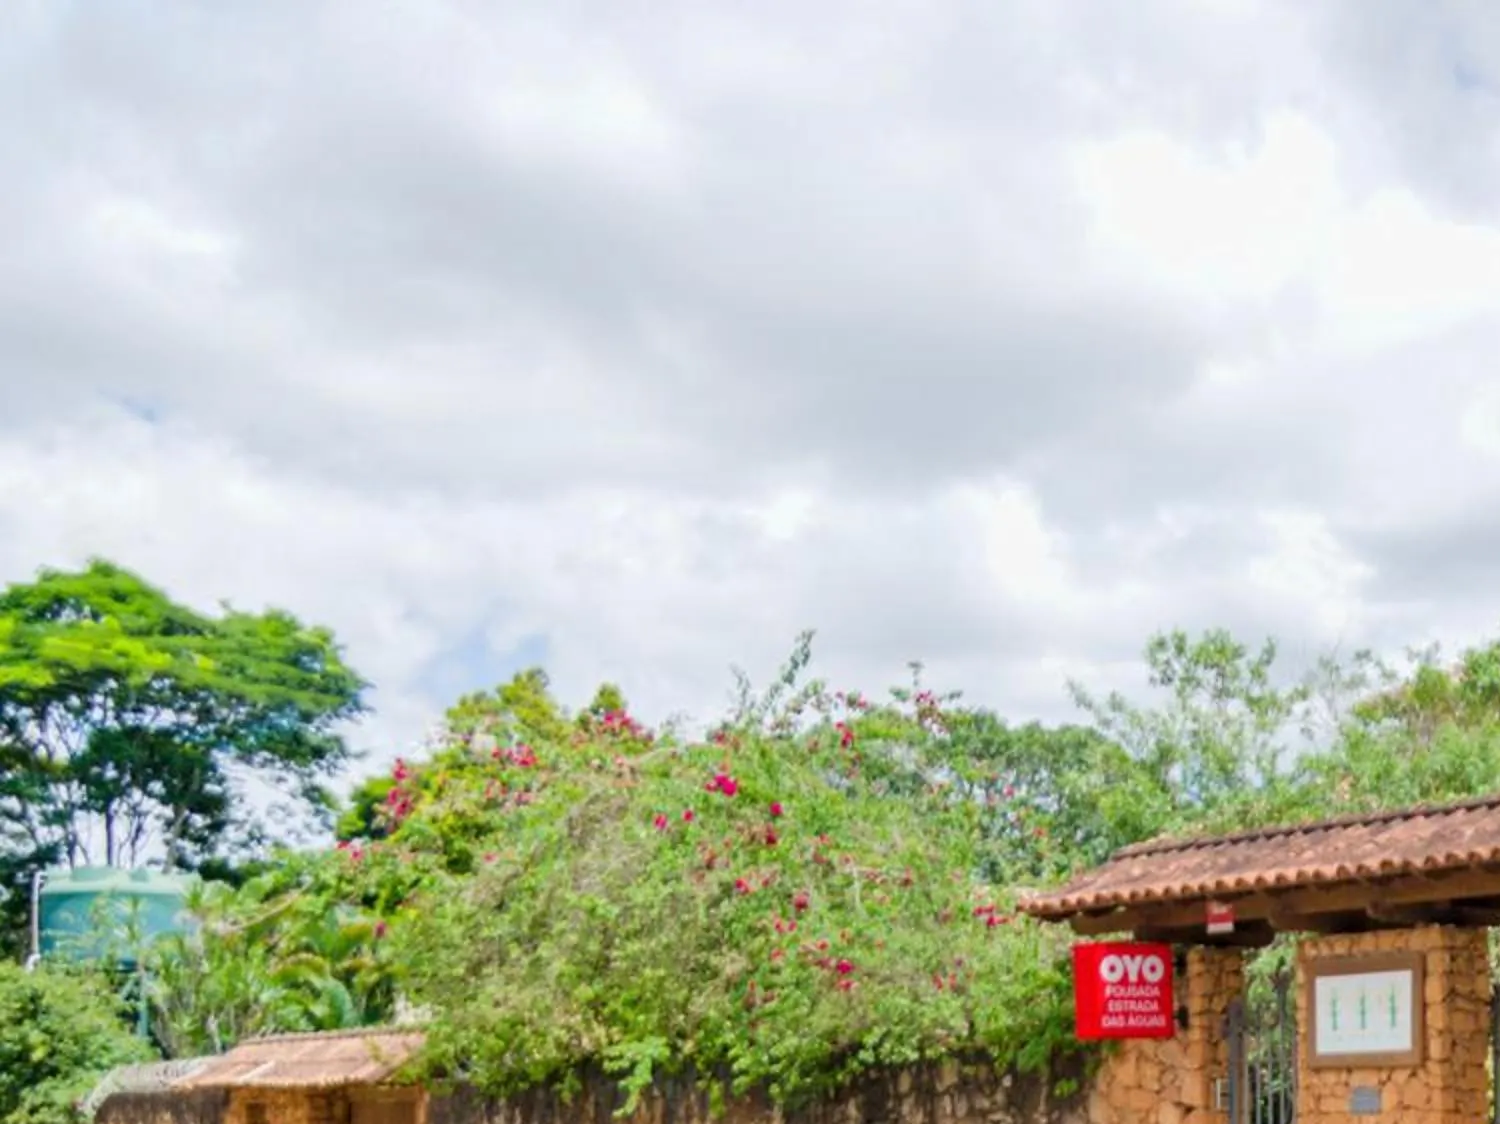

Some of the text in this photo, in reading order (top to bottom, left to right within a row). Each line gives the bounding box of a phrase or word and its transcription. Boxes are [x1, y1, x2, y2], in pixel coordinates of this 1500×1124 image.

[1100, 954, 1164, 983] OYO
[1105, 985, 1160, 997] POUSADA
[1108, 1000, 1159, 1012] ESTRADA
[1102, 1015, 1126, 1027] DAS
